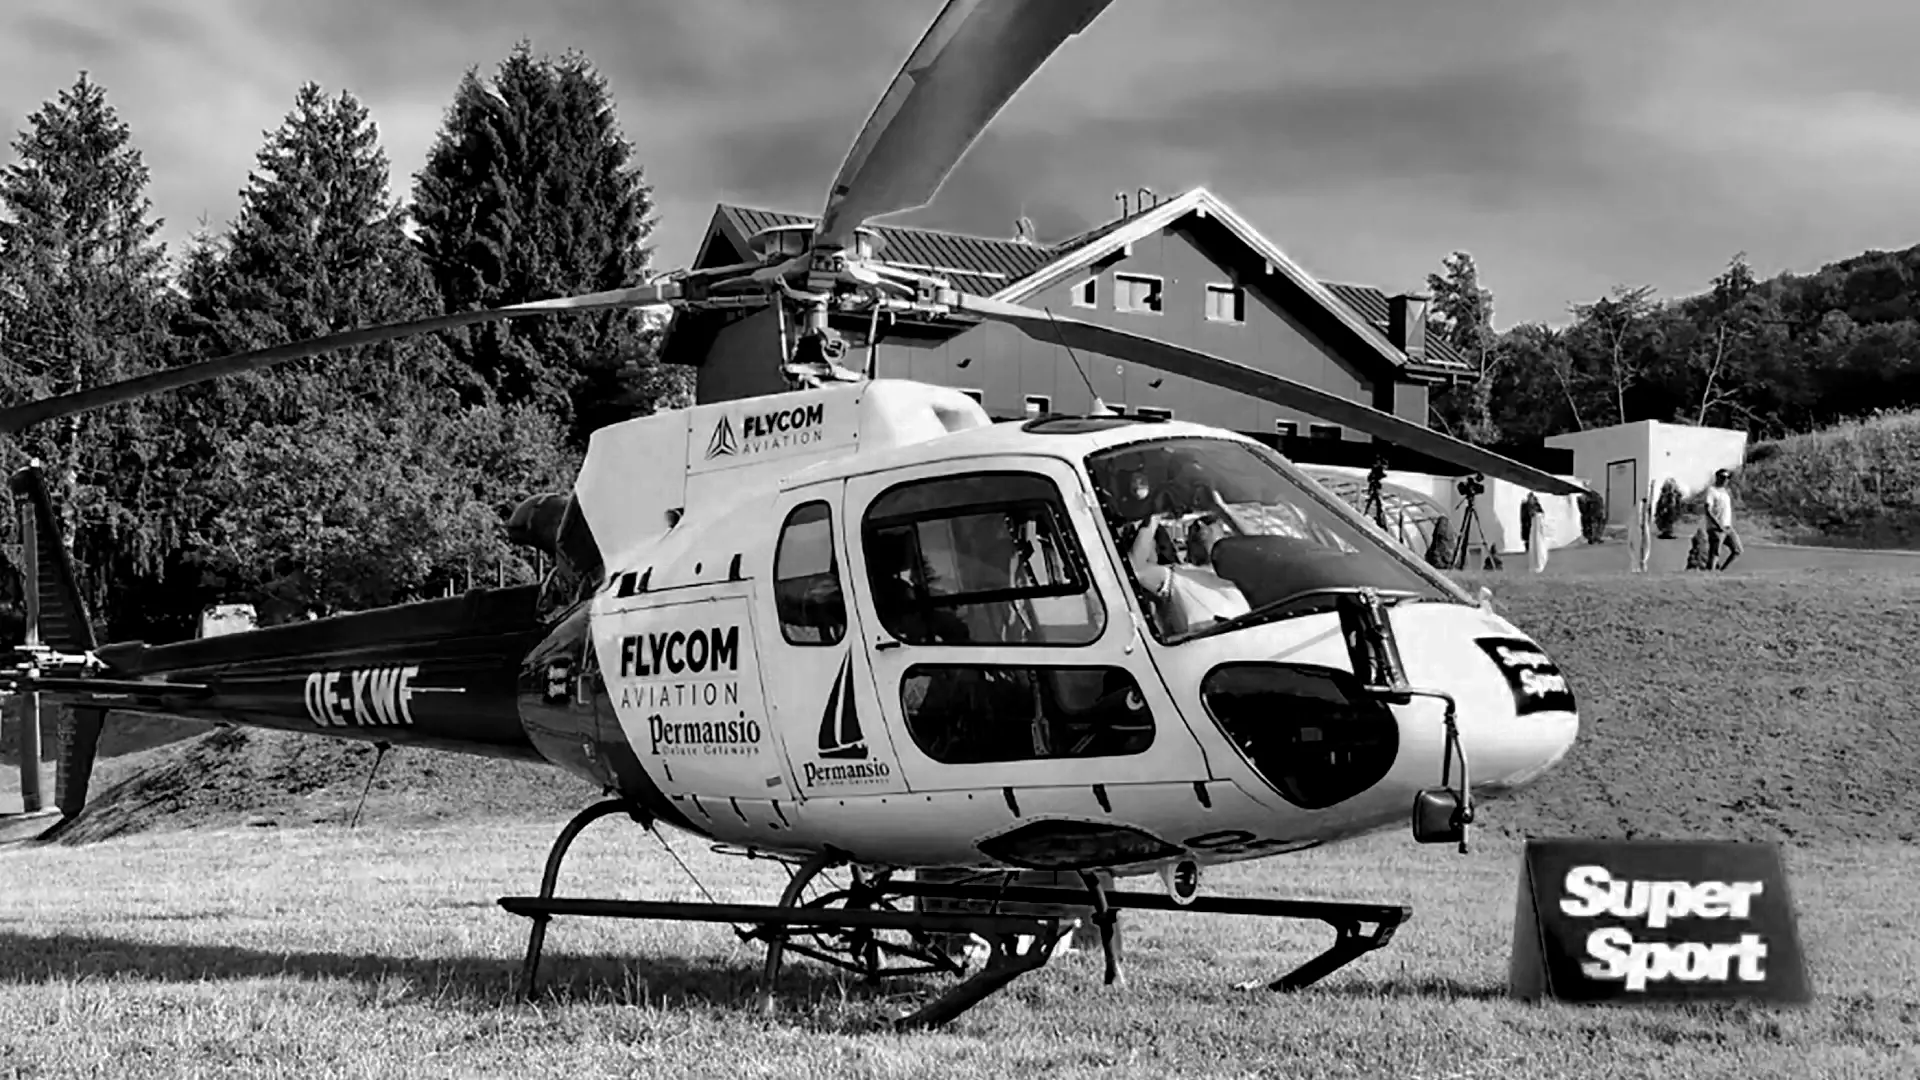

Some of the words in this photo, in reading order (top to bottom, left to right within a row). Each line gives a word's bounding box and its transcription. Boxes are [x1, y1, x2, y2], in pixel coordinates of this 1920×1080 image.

[742, 430, 822, 455] AVIATION
[744, 403, 824, 438] FLYCOM
[621, 626, 739, 677] FLYCOM
[305, 666, 419, 727] OE-KWF
[621, 682, 737, 708] AVIATION
[1559, 865, 1763, 928] Super
[1581, 927, 1767, 991] Sport
